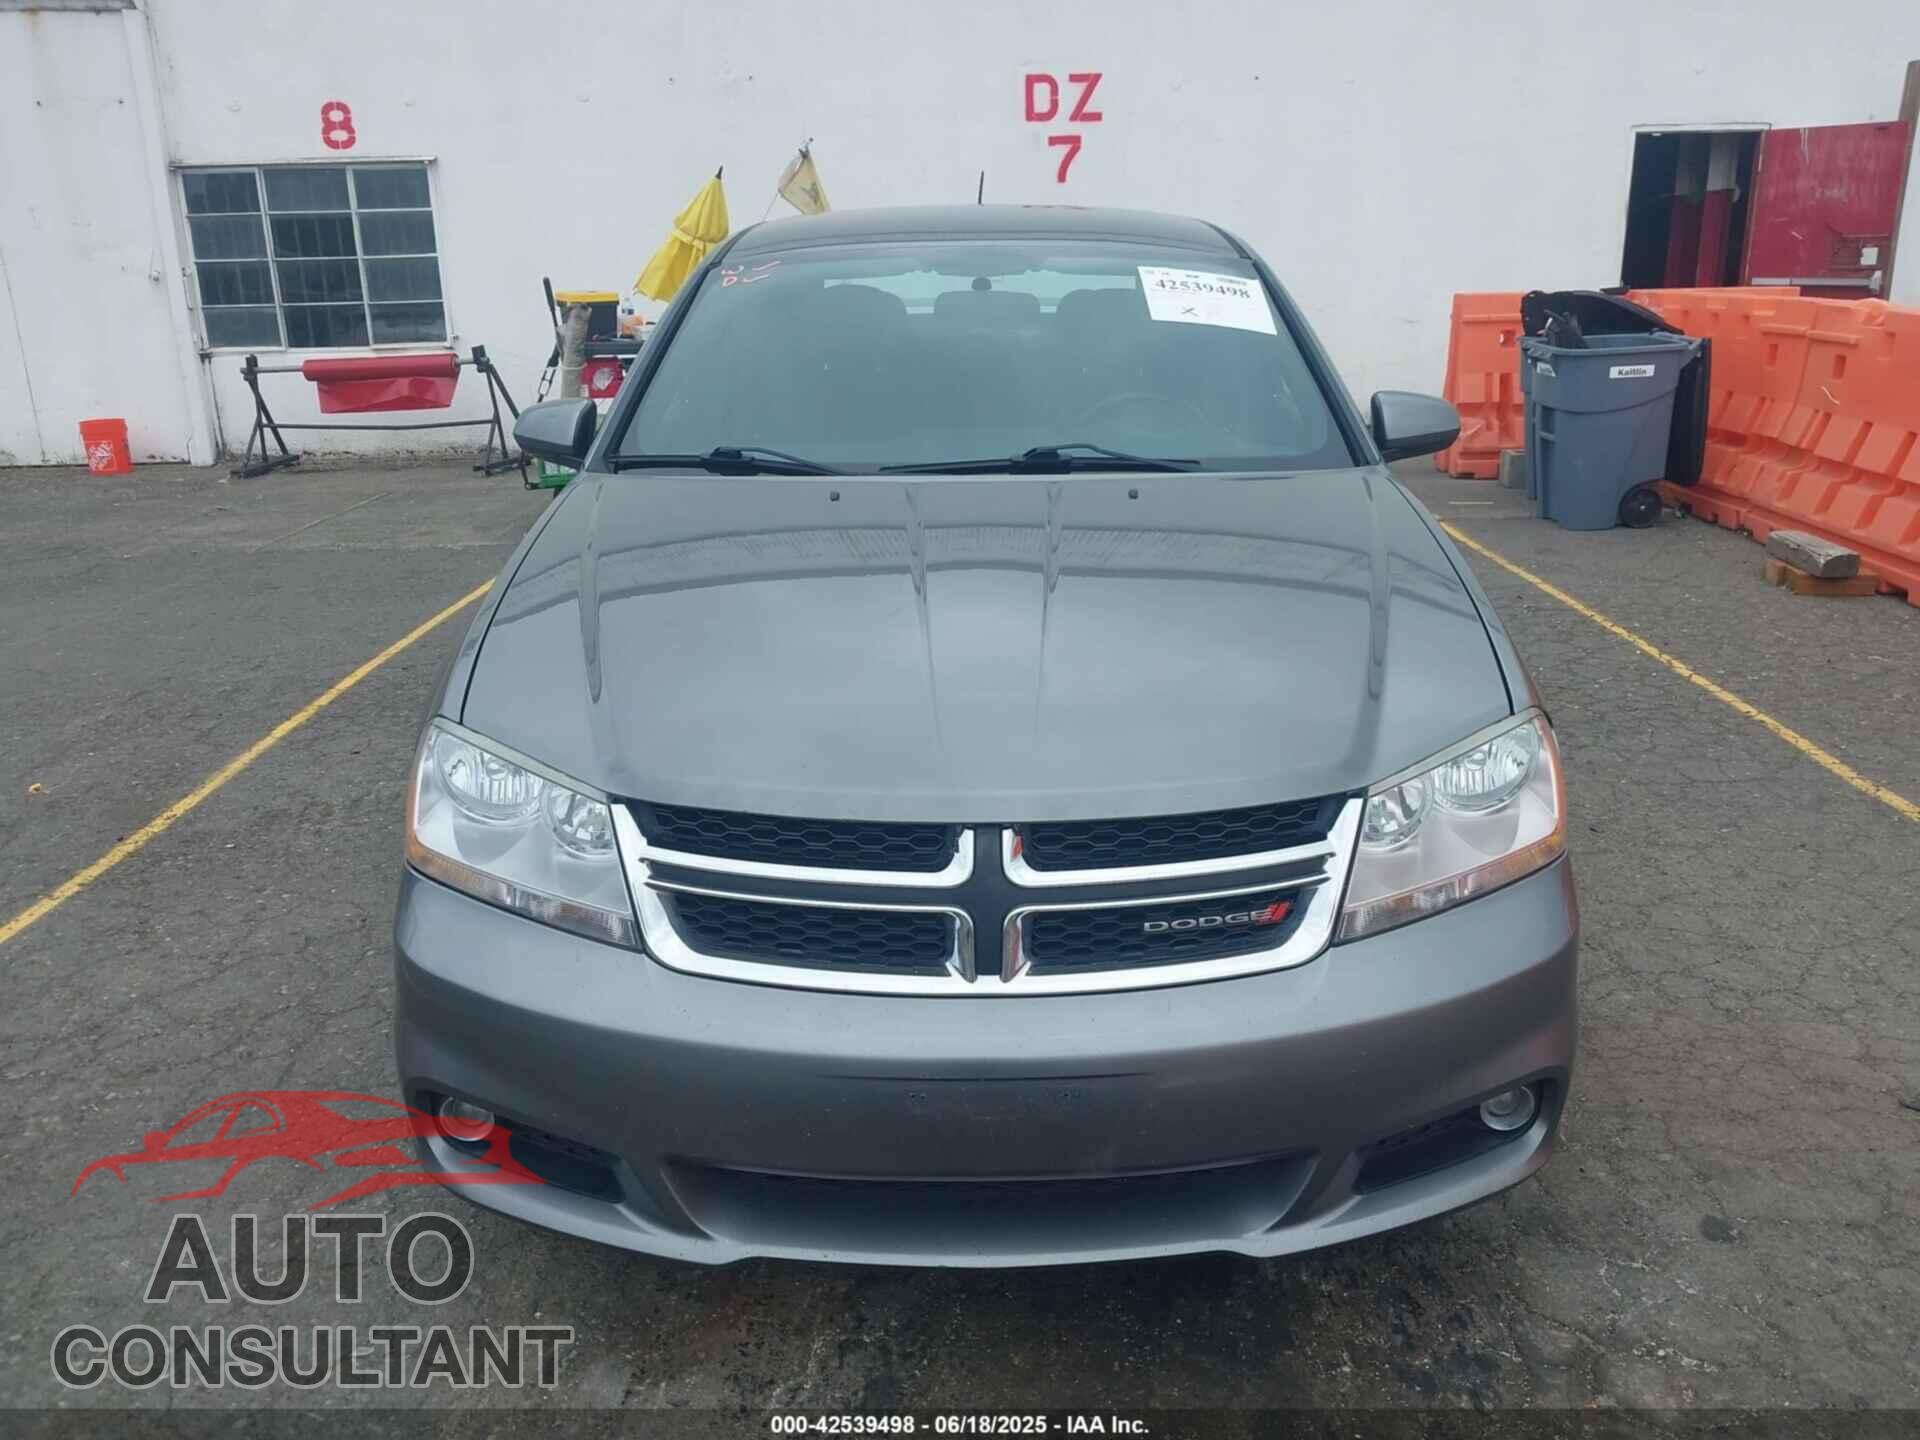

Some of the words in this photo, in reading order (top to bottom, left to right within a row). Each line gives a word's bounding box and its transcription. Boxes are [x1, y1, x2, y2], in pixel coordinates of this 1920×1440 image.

[1025, 73, 1103, 121] DZ
[321, 101, 356, 150] 8
[1047, 135, 1082, 183] 7
[1154, 278, 1251, 299] 42539498
[1143, 909, 1275, 932] DODGE
